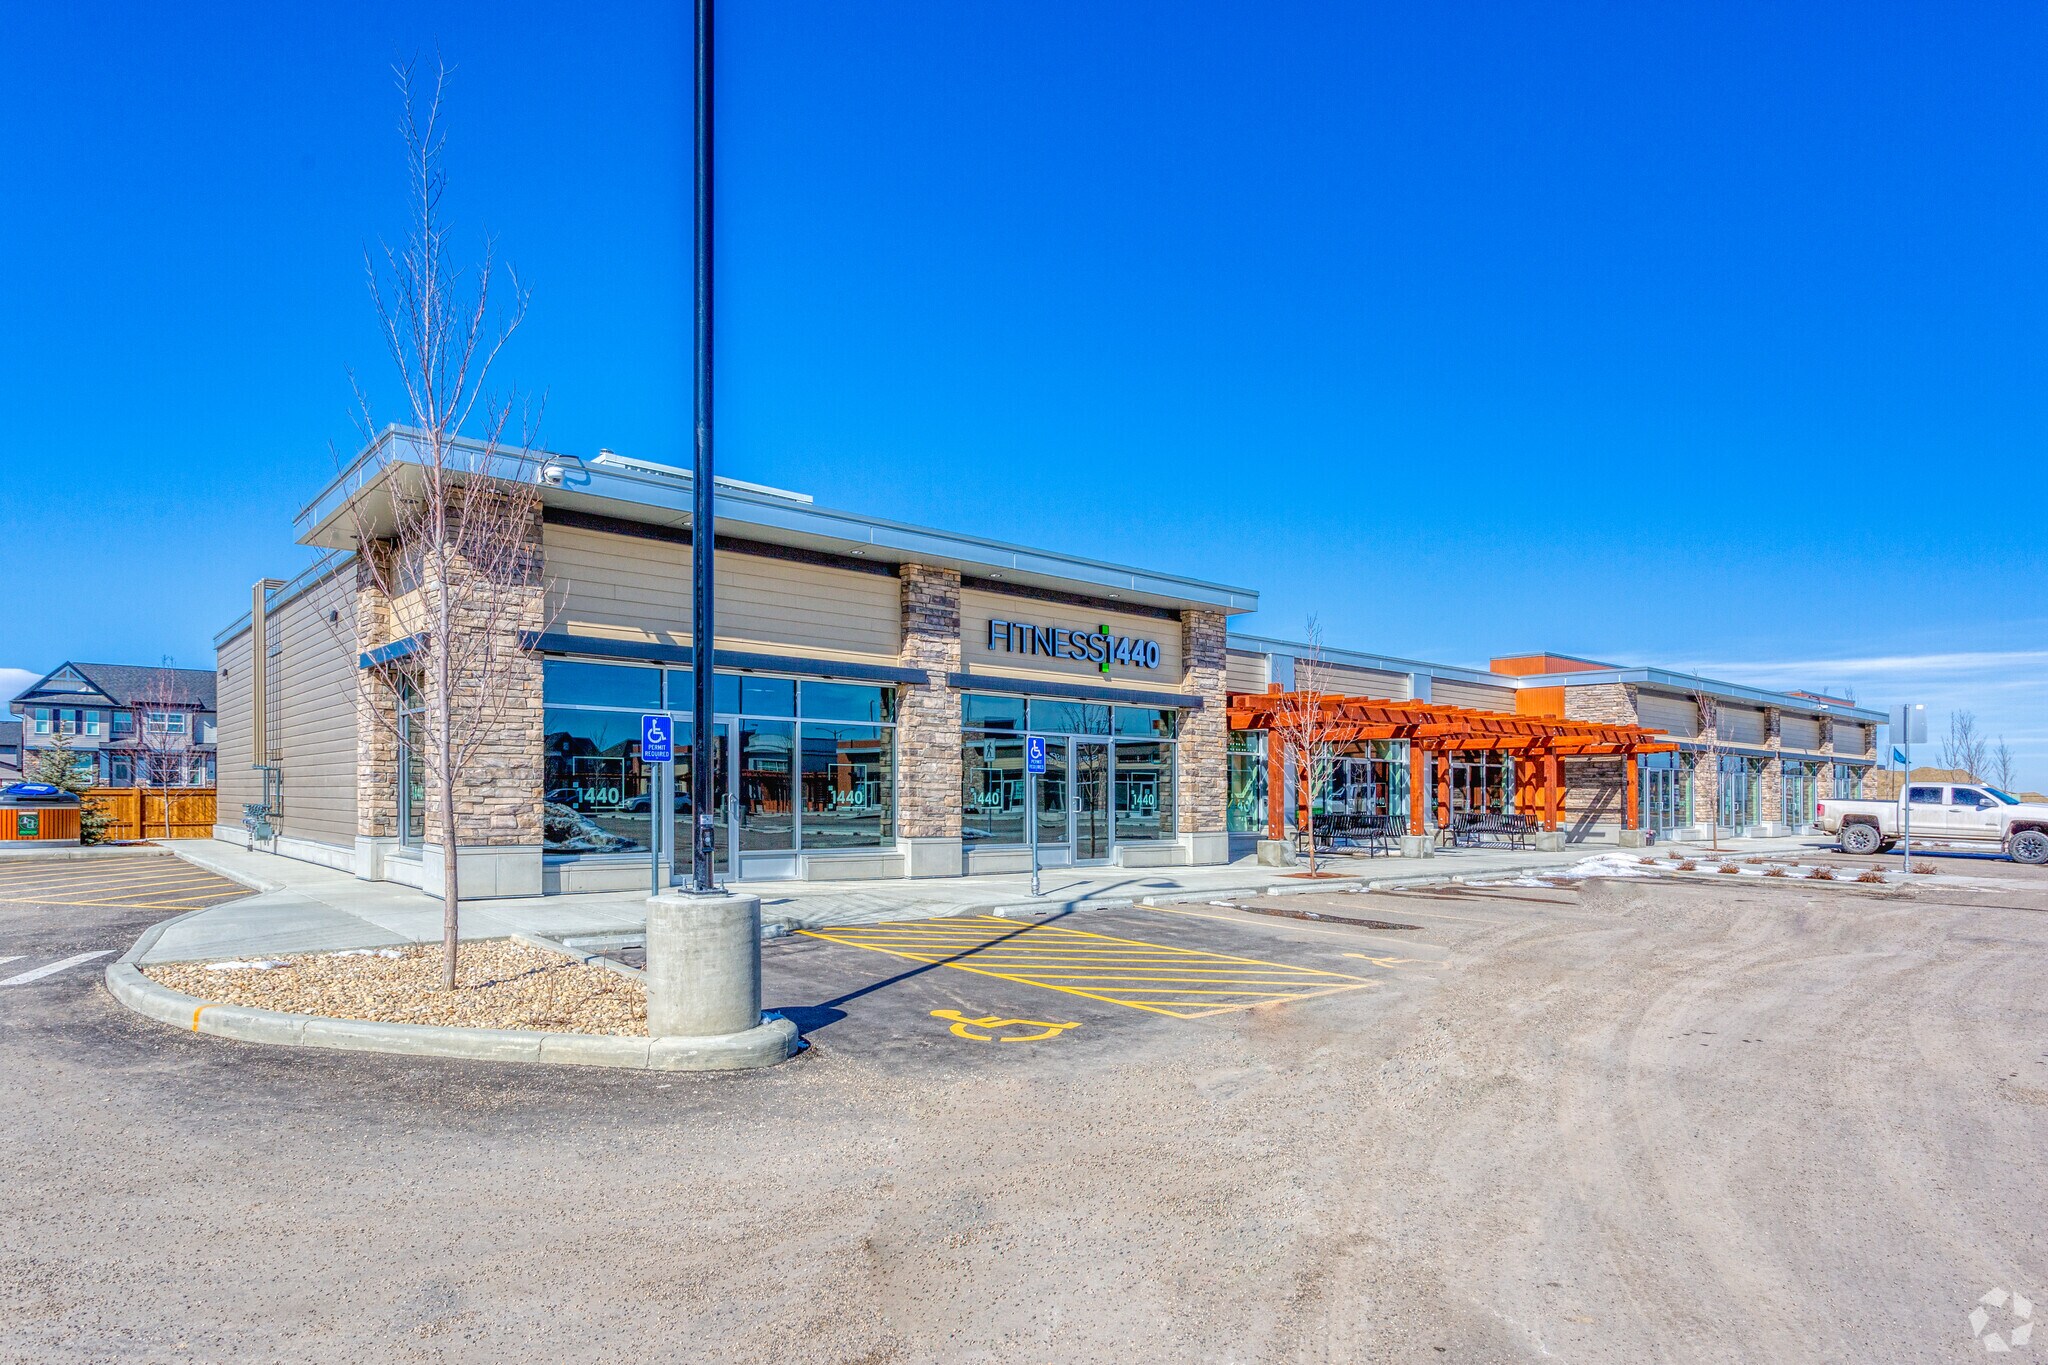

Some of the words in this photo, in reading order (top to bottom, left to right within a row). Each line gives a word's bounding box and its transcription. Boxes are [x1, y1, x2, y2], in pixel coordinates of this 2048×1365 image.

[576, 787, 620, 804] 1440
[831, 790, 863, 805] 1440
[972, 791, 1000, 805] 1440
[1133, 793, 1155, 806] 1440
